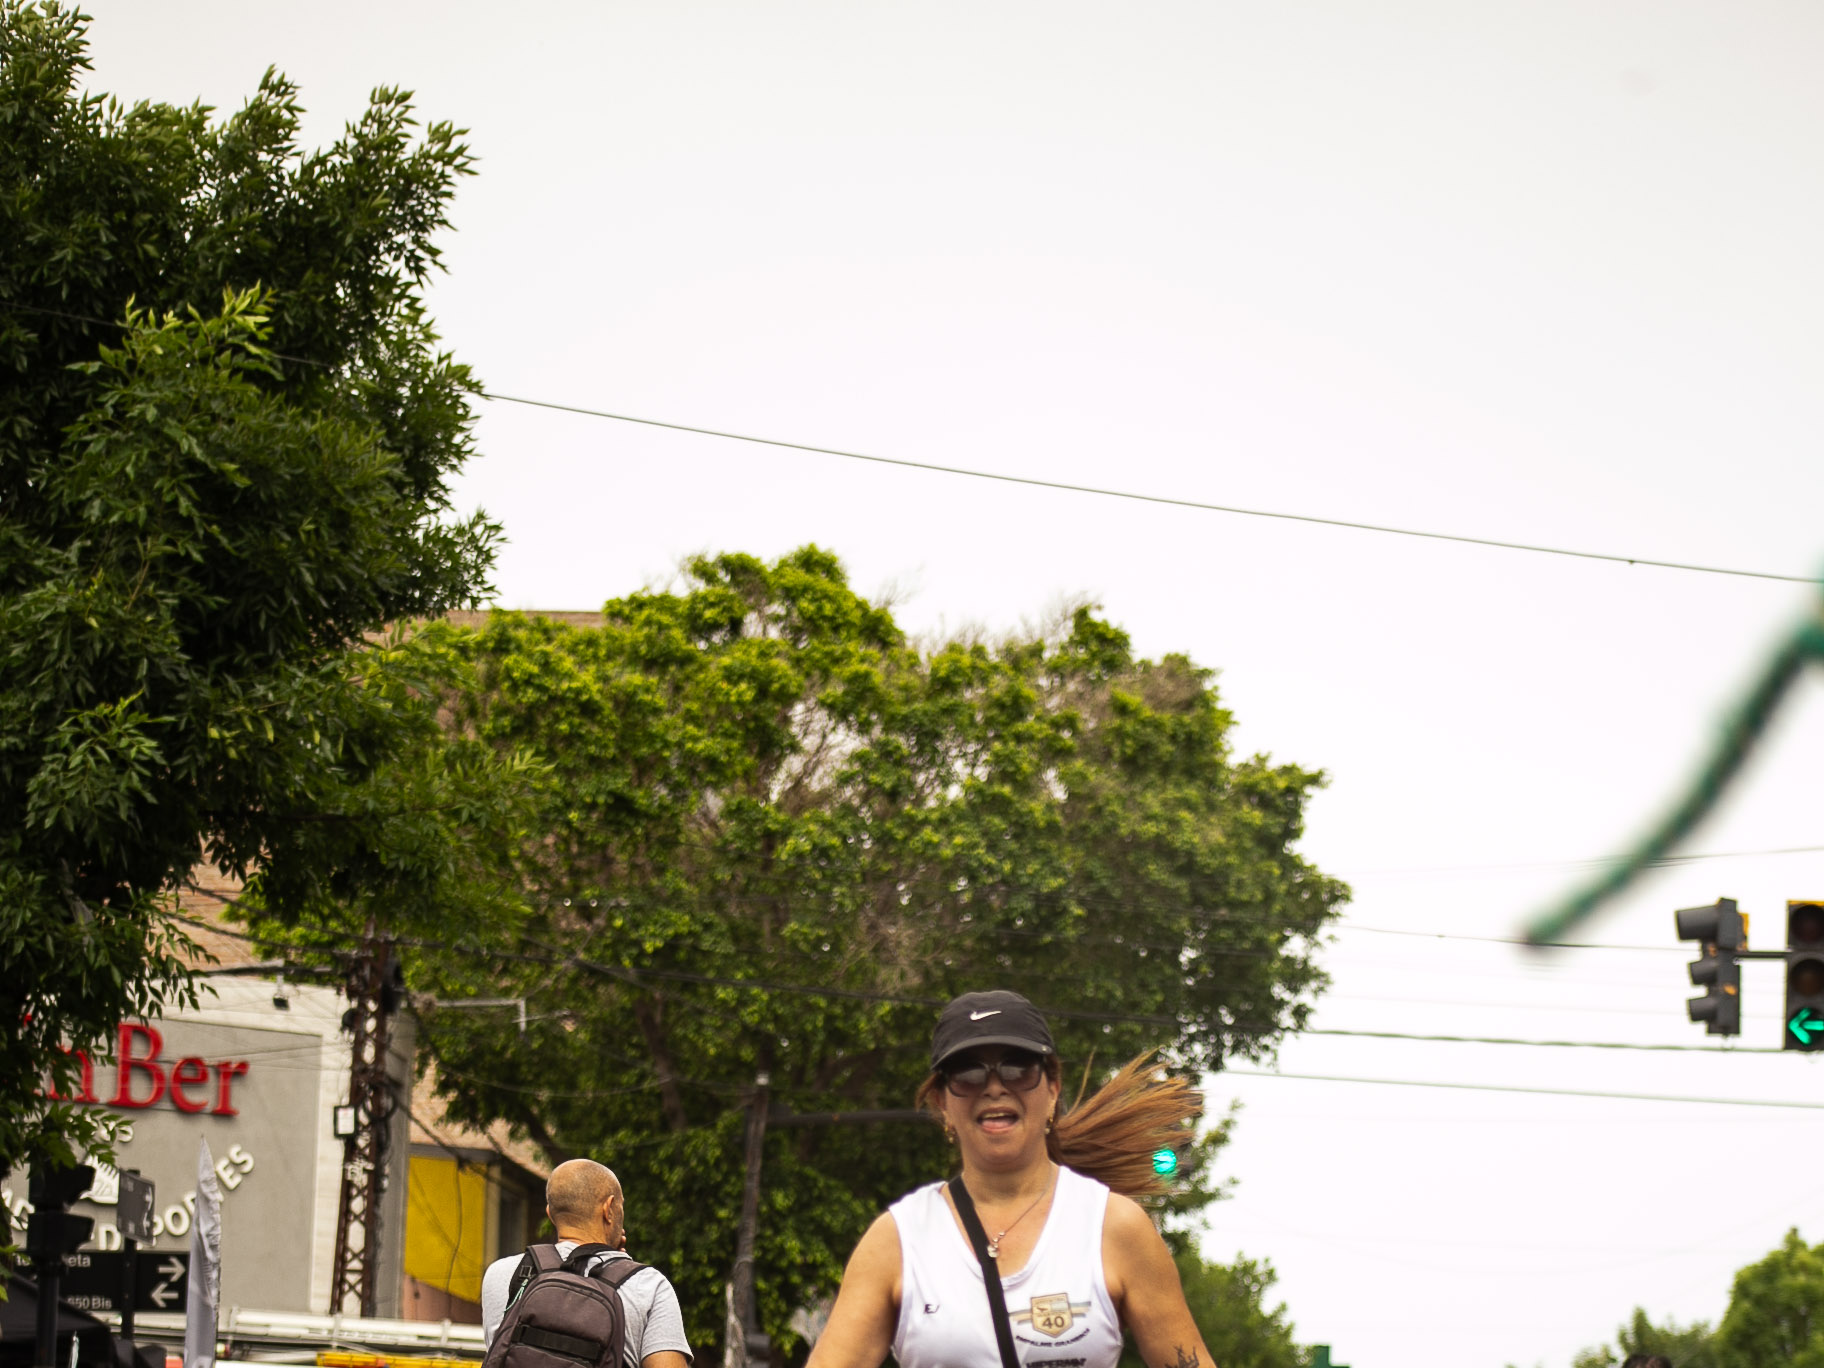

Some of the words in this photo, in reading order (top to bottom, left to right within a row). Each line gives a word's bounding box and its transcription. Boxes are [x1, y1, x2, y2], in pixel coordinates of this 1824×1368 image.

[24, 1013, 249, 1116] nBer
[91, 1296, 112, 1310] Bis
[1042, 1316, 1065, 1329] 40
